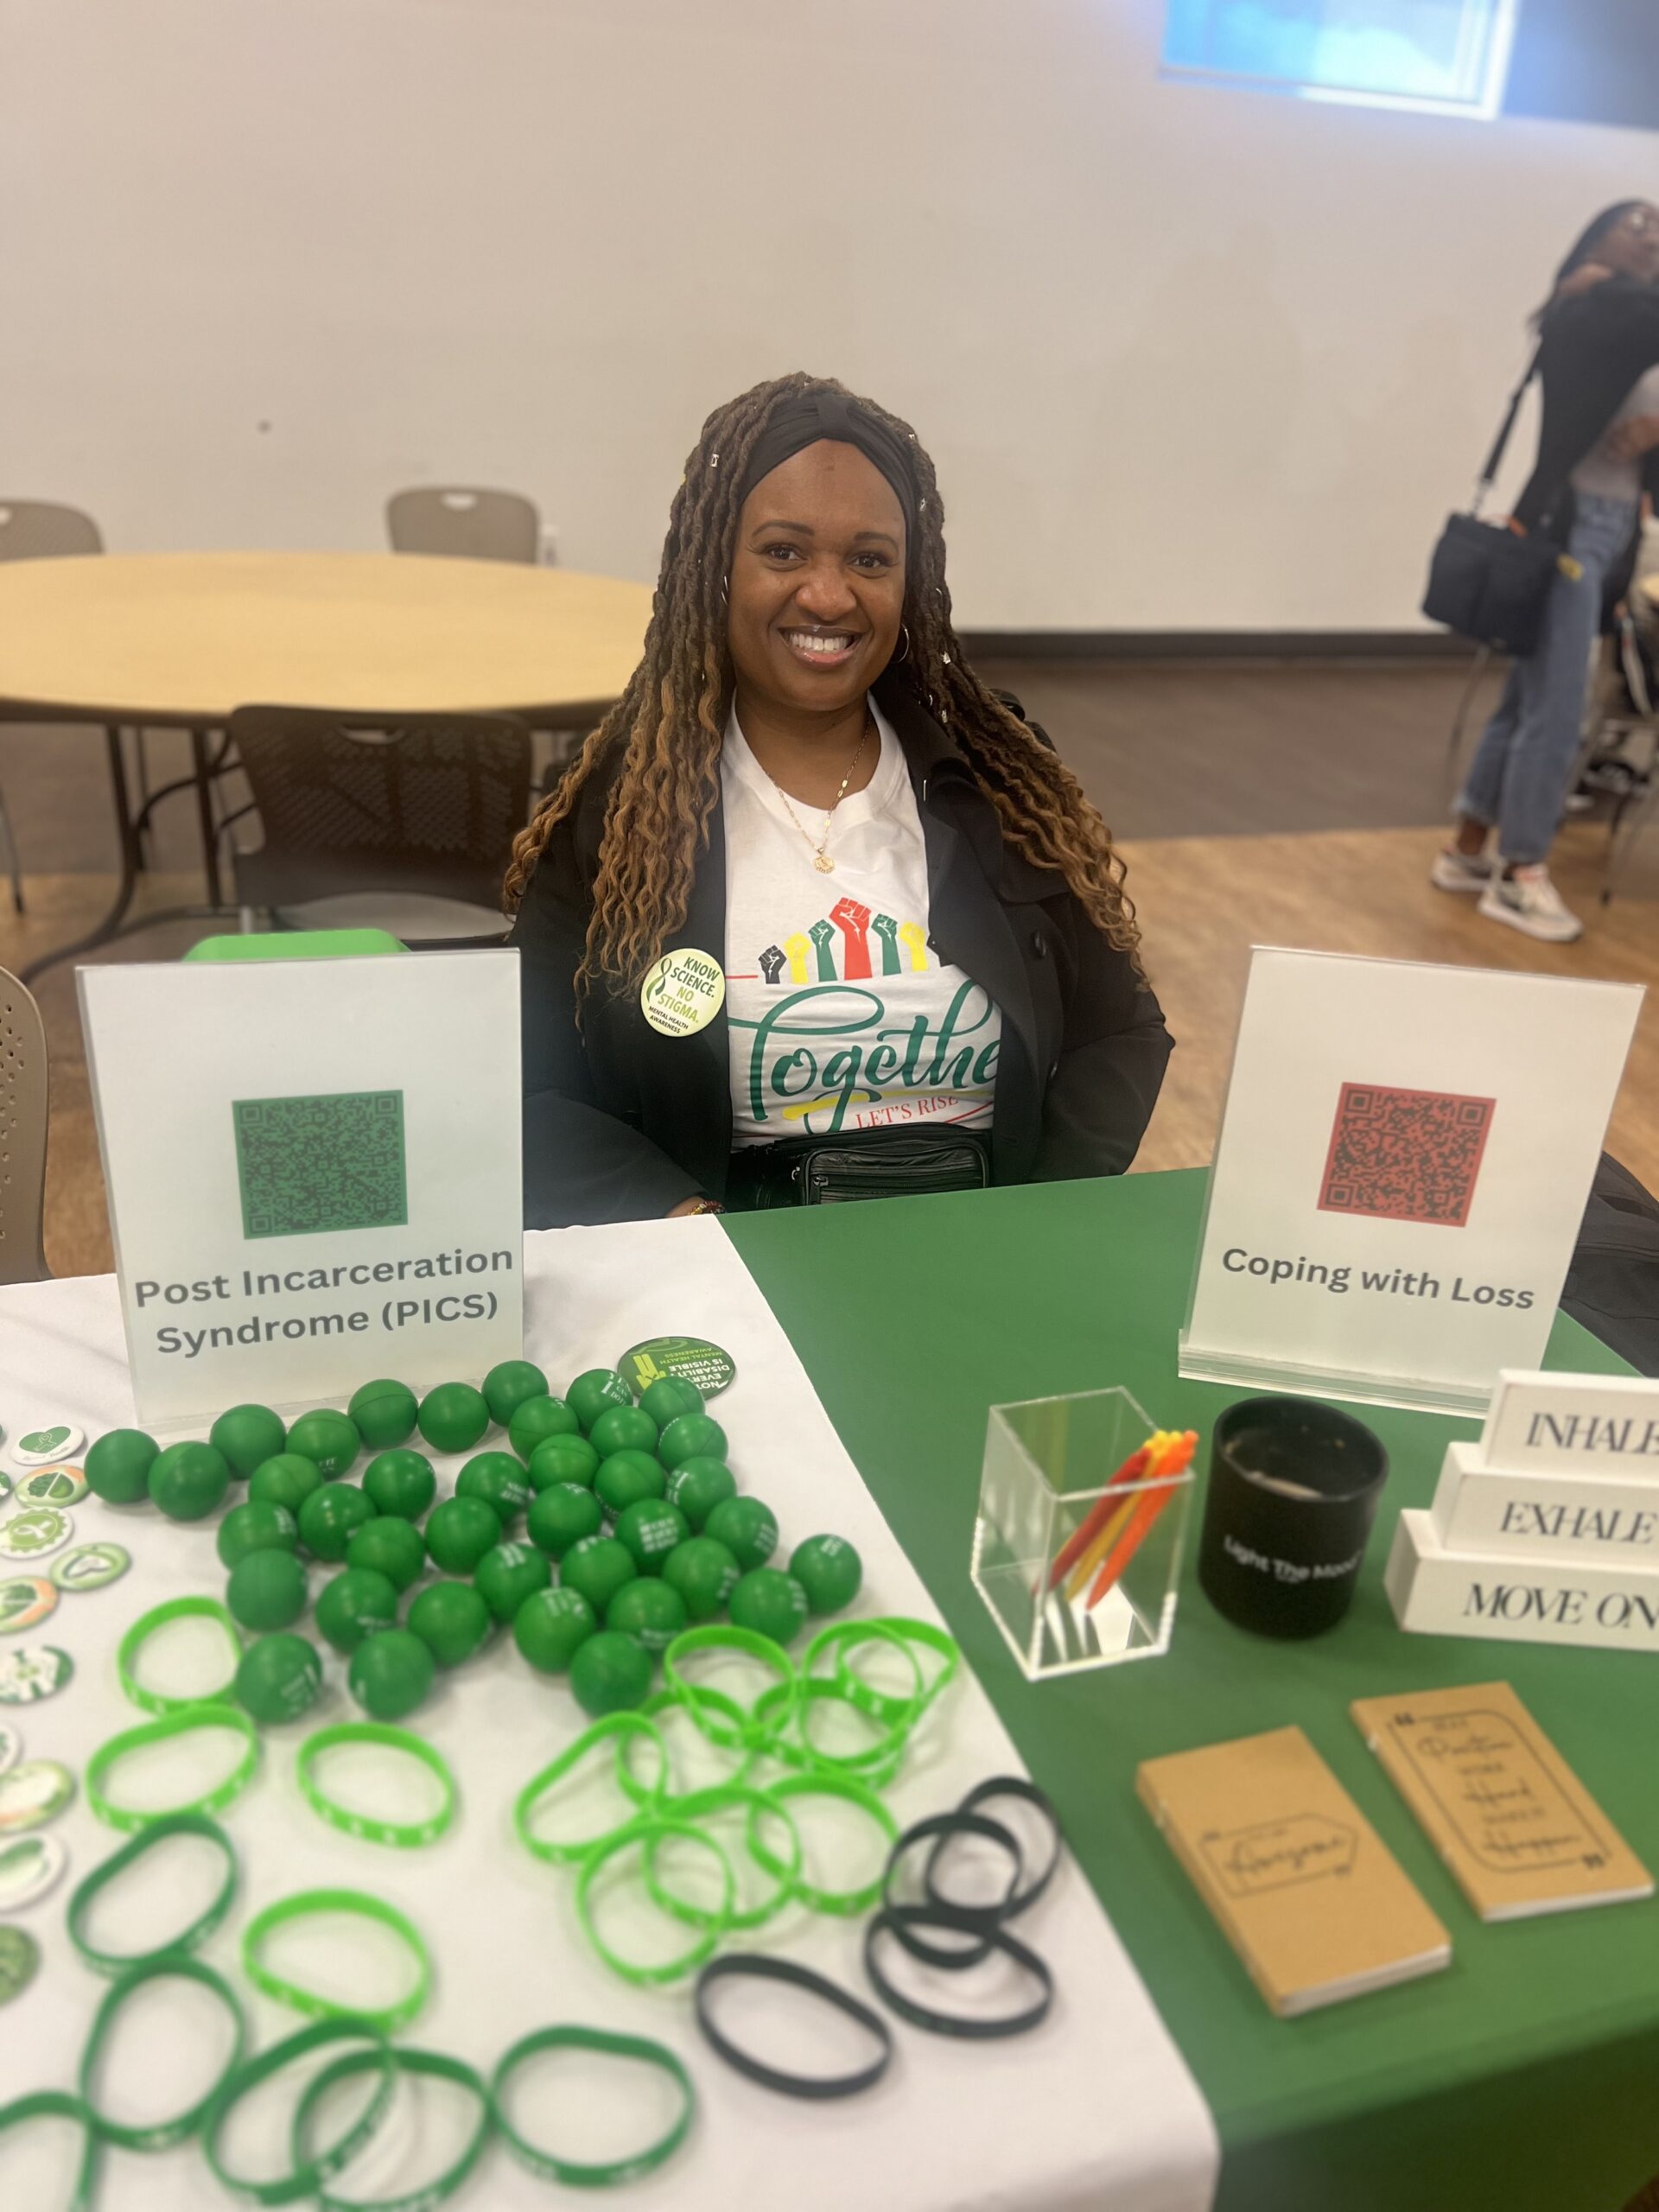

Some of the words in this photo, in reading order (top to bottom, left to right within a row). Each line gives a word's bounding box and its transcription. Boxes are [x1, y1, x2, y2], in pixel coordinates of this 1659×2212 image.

[670, 967, 715, 998] SCIENCE.
[683, 957, 721, 982] KNOW
[676, 986, 694, 1001] NO
[648, 1006, 669, 1020] MENTAL
[669, 1016, 690, 1030] HEALTH
[657, 994, 699, 1023] STIGMA.
[649, 1014, 681, 1034] AWARENESS
[728, 979, 1001, 1134] Togethe
[917, 1095, 959, 1116] RISE
[135, 1274, 232, 1308] Post
[243, 1249, 514, 1297] Incarceration
[1222, 1249, 1351, 1294] Coping
[1361, 1269, 1440, 1299] with
[1451, 1277, 1535, 1309] Loss
[156, 1311, 369, 1359] Syndrome
[382, 1292, 499, 1332] (PICS)
[664, 1347, 712, 1358] AWARENESS
[669, 1360, 710, 1372] VISIBLE
[670, 1364, 730, 1378] DISABILIT
[1500, 1501, 1658, 1545] EXHALE
[1224, 1535, 1269, 1573] Light
[1273, 1559, 1310, 1580] The
[1463, 1583, 1588, 1625] MOVE
[1595, 1592, 1659, 1630] ON
